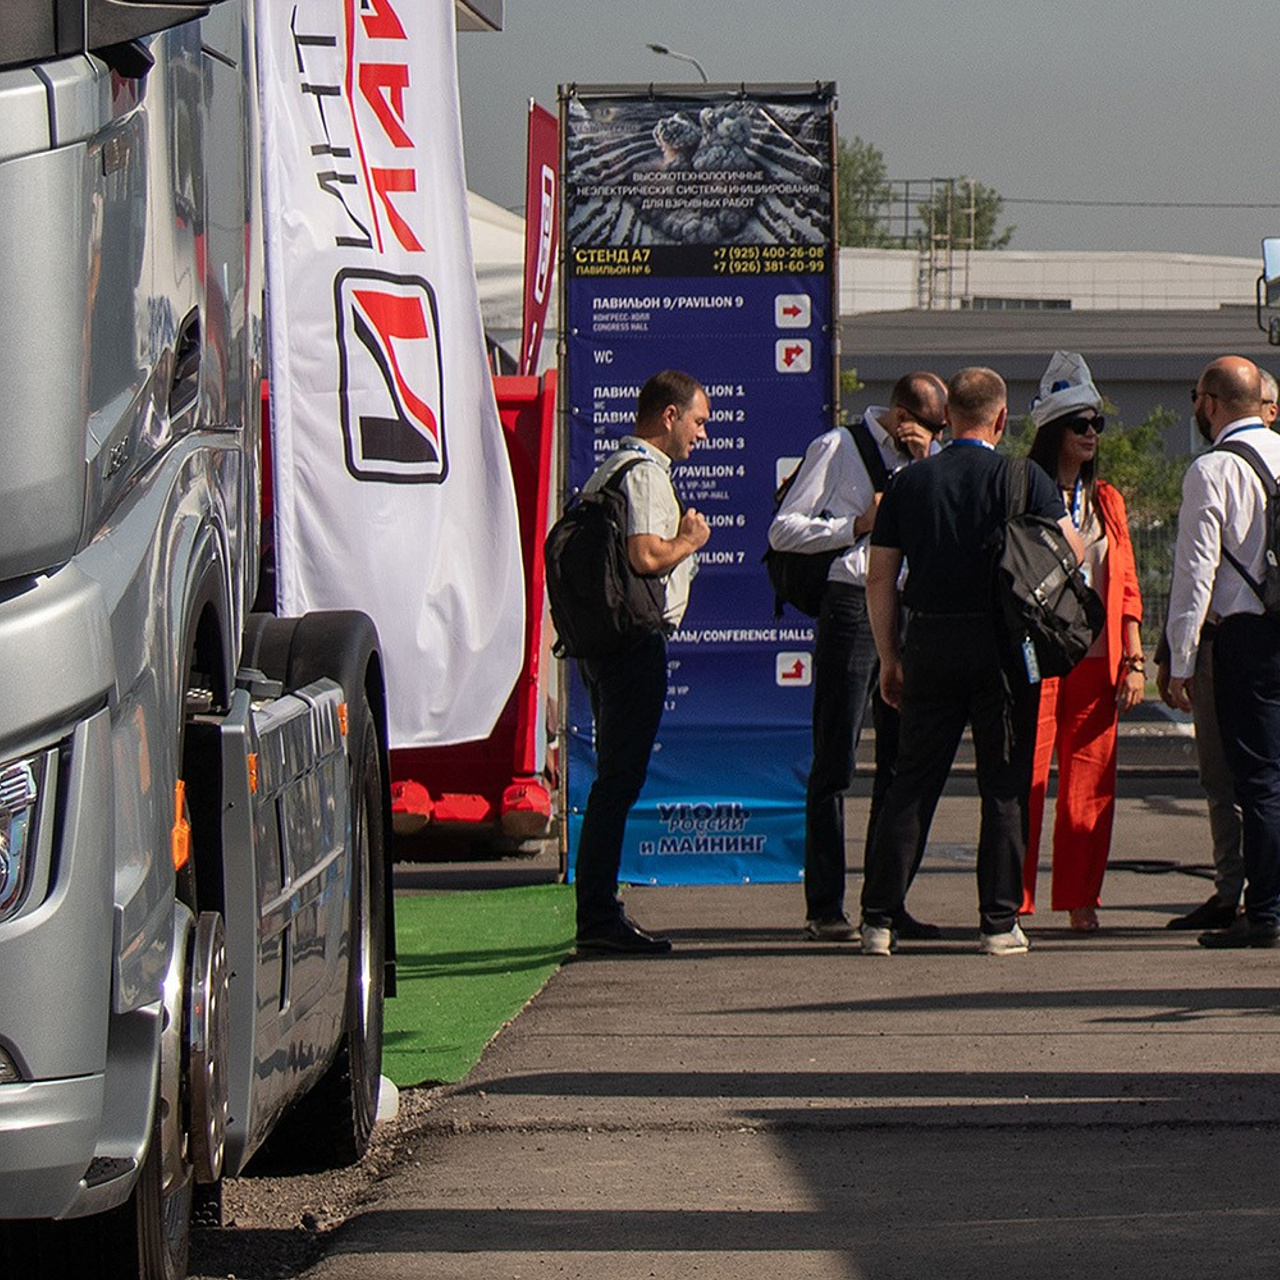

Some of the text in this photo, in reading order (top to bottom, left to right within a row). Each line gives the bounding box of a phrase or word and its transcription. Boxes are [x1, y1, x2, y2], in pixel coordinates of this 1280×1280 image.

[633, 171, 763, 181] ВЫСОКОТЕХНОЛОГИЧНЫЕ
[577, 184, 819, 195] НЕЭЛЕКТРИЧЕСКИЕ СИСТЕМЫ ИНИЦИИРОВАНИЯ
[641, 197, 755, 209] ДЛЯ ВЗРЫВНЫХ РАБОТ
[575, 249, 651, 264] СТЕНД А7
[714, 246, 824, 259] +7 (925) 400-26-08
[575, 265, 631, 275] ПАВИЛЬОН
[713, 260, 824, 273] +7 (926) 381-60-99
[592, 296, 744, 310] ПАВИЛЬОН 9/PAVILION 9
[592, 323, 648, 331] CONGRESS HALL
[593, 350, 614, 364] WC
[736, 386, 745, 396] 1
[736, 410, 745, 421] 2
[736, 438, 745, 449] 3
[736, 465, 745, 477] 4
[736, 514, 745, 527] 6
[736, 551, 745, 563] 7
[779, 628, 814, 641] HALLS
[657, 802, 751, 822] УГОЛЬ
[669, 817, 746, 832] РОССИИ
[657, 831, 767, 855] МАЙНИНГ
